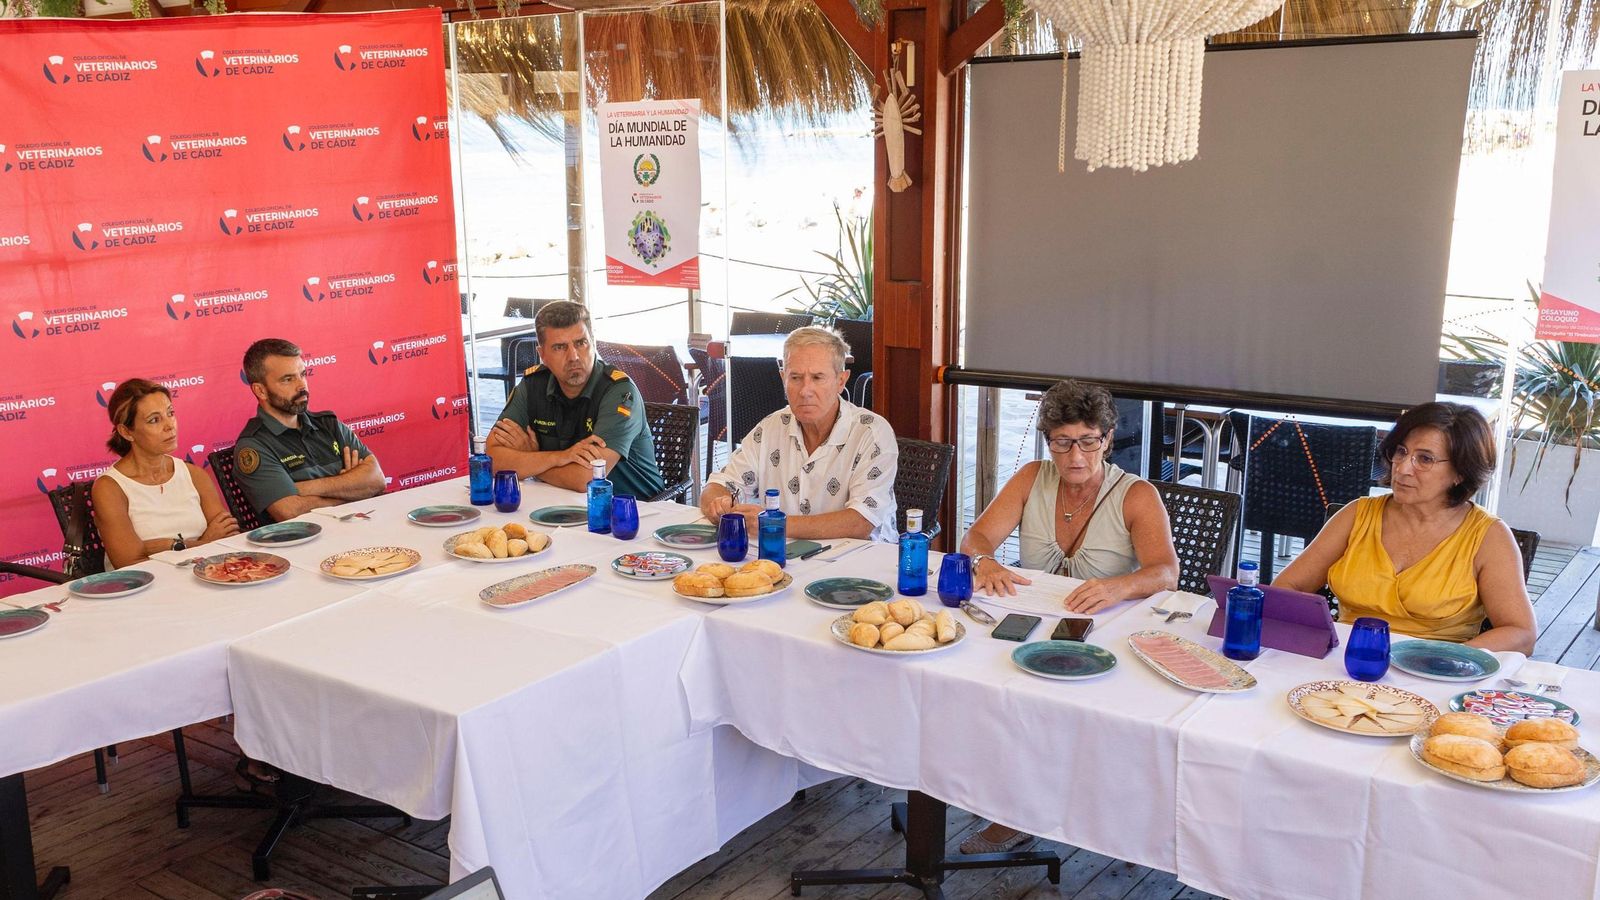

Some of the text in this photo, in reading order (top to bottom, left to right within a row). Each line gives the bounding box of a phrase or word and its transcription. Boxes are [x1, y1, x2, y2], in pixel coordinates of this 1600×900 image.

[223, 54, 299, 65] VETERINARIOS
[360, 48, 428, 60] VETERINARIOS
[74, 61, 158, 72] VETERINARIOS
[226, 64, 274, 76] DE CÁDIZ
[362, 59, 406, 70] DE CÁDIZ
[77, 71, 131, 83] DE CÁDIZ
[1582, 83, 1594, 92] LA
[309, 127, 380, 140] VETERINARIOS
[608, 120, 687, 134] DÍA MUNDIAL DE
[171, 136, 247, 150] VETERINARIOS
[311, 138, 356, 150] DE CÁDIZ
[610, 134, 686, 147] LA HUMANIDAD
[16, 146, 103, 160] VETERINARIOS
[173, 148, 222, 160] DE CÁDIZ
[19, 156, 75, 171] DE CÁDIZ
[377, 196, 438, 210] VETERINARIOS
[246, 208, 318, 223] VETERINARIOS
[379, 207, 419, 220] DE CÁDIZ
[103, 222, 182, 237] VETERINARIOS
[248, 220, 294, 233] DE CÁDIZ
[123, 235, 156, 246] CÁDIZ
[328, 274, 395, 290] VETERINARIOS
[194, 290, 268, 307] VETERINARIOS
[330, 286, 374, 299] DE CÁDIZ
[44, 308, 128, 326] VETERINARIOS
[196, 303, 244, 318] DE CÁDIZ
[46, 322, 100, 336] DE CÁDIZ
[391, 334, 447, 353] VETERINARIOS
[392, 348, 428, 361] DE CÁDIZ
[359, 426, 385, 438] CÁDIZ
[399, 466, 457, 486] VETERINARIOS
